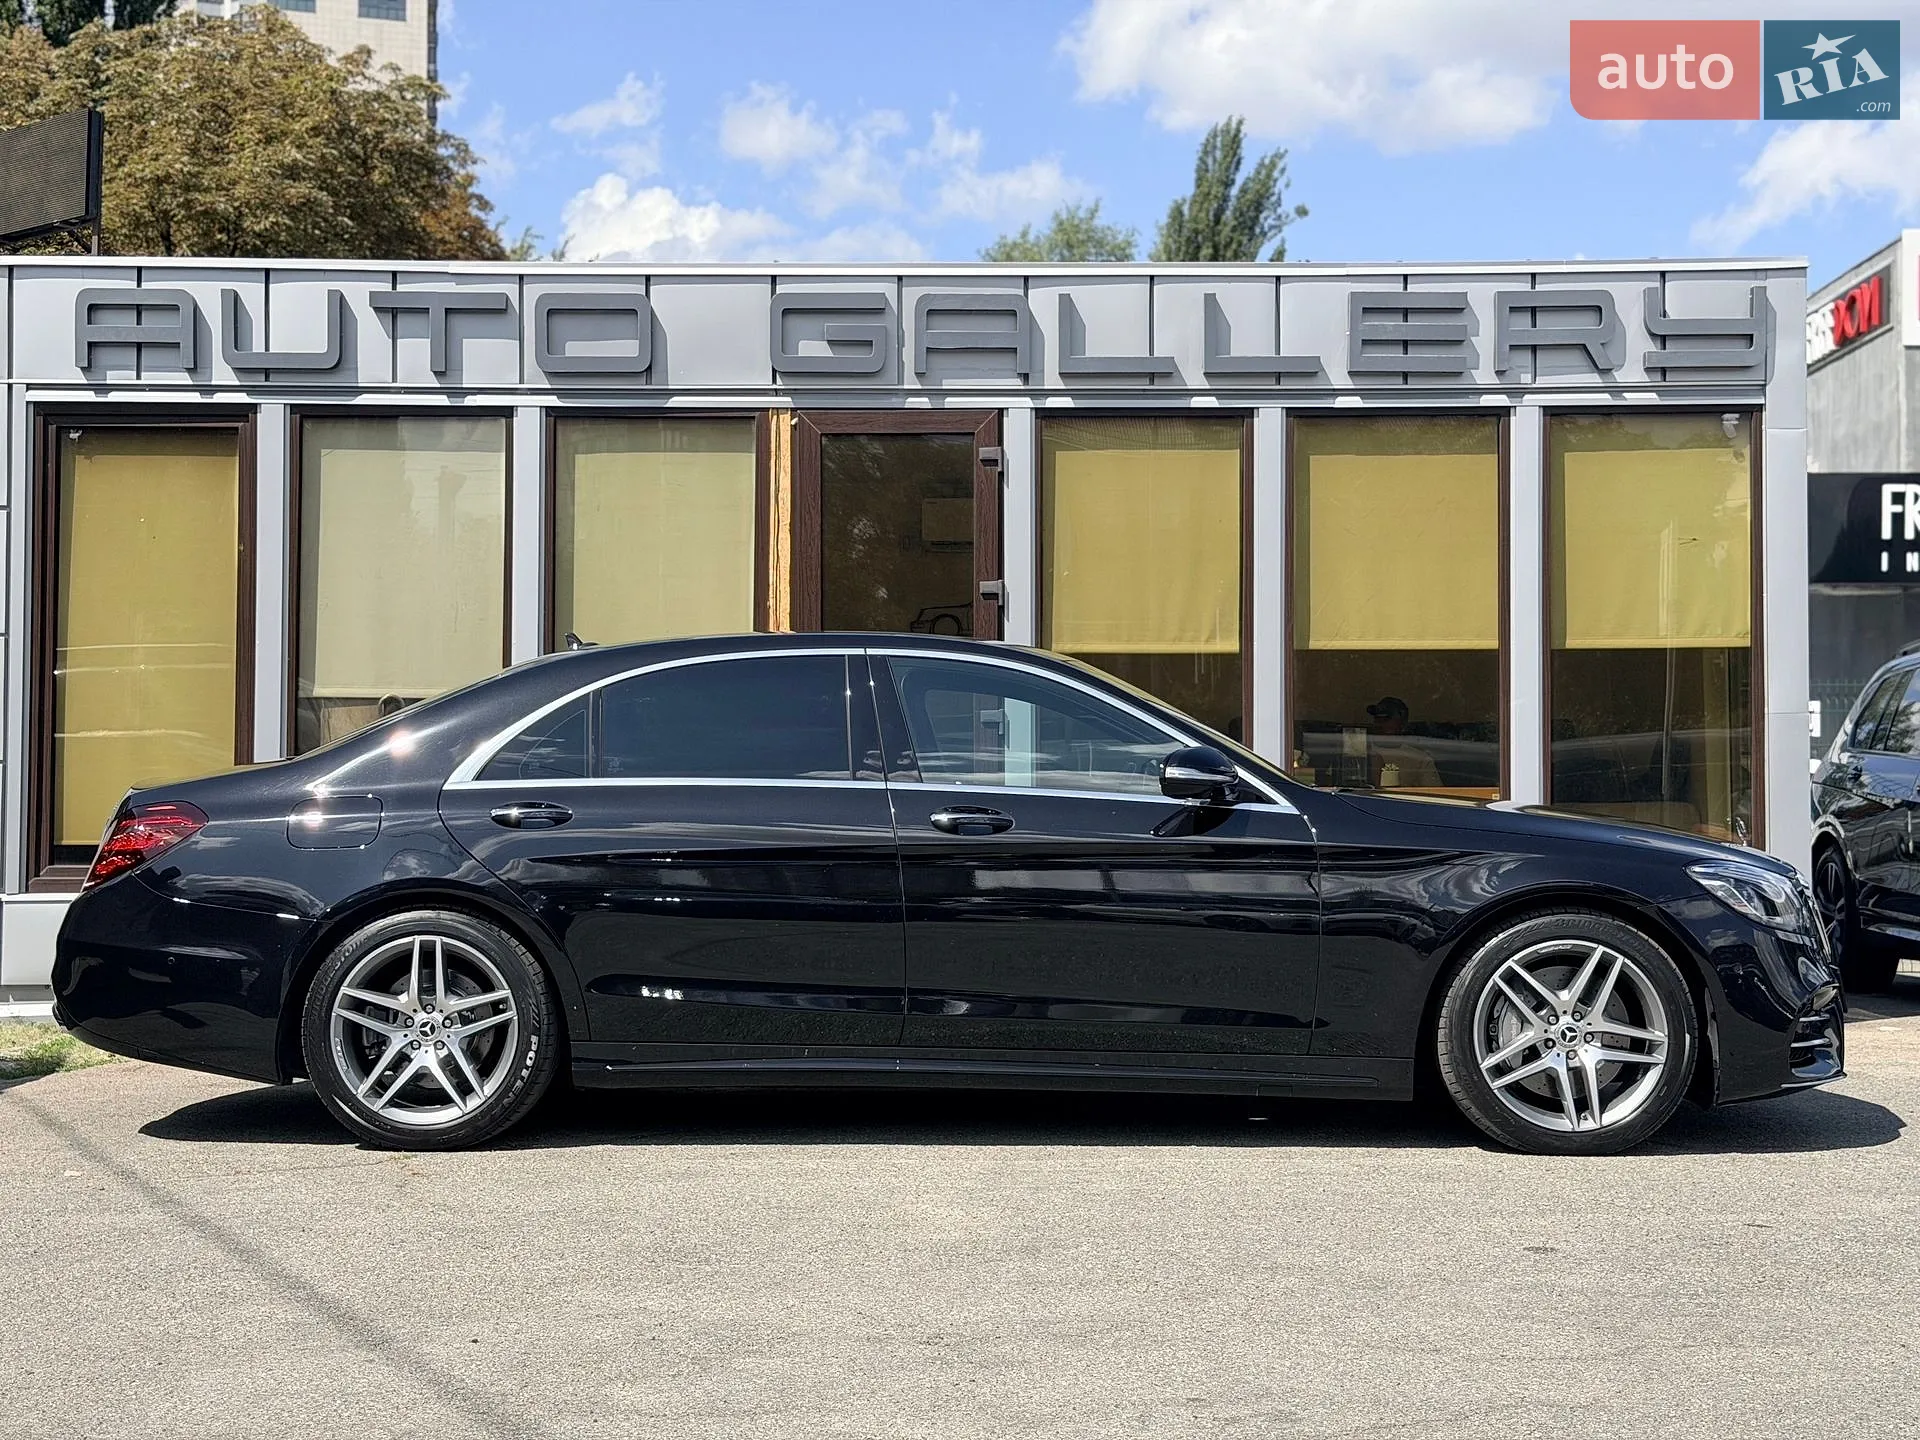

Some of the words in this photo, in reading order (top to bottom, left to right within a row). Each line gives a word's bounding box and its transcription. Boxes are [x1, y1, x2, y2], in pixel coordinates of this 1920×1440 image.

[75, 288, 653, 373] AUTO
[770, 286, 1768, 375] GALLERY
[498, 1034, 540, 1110] POTEN
